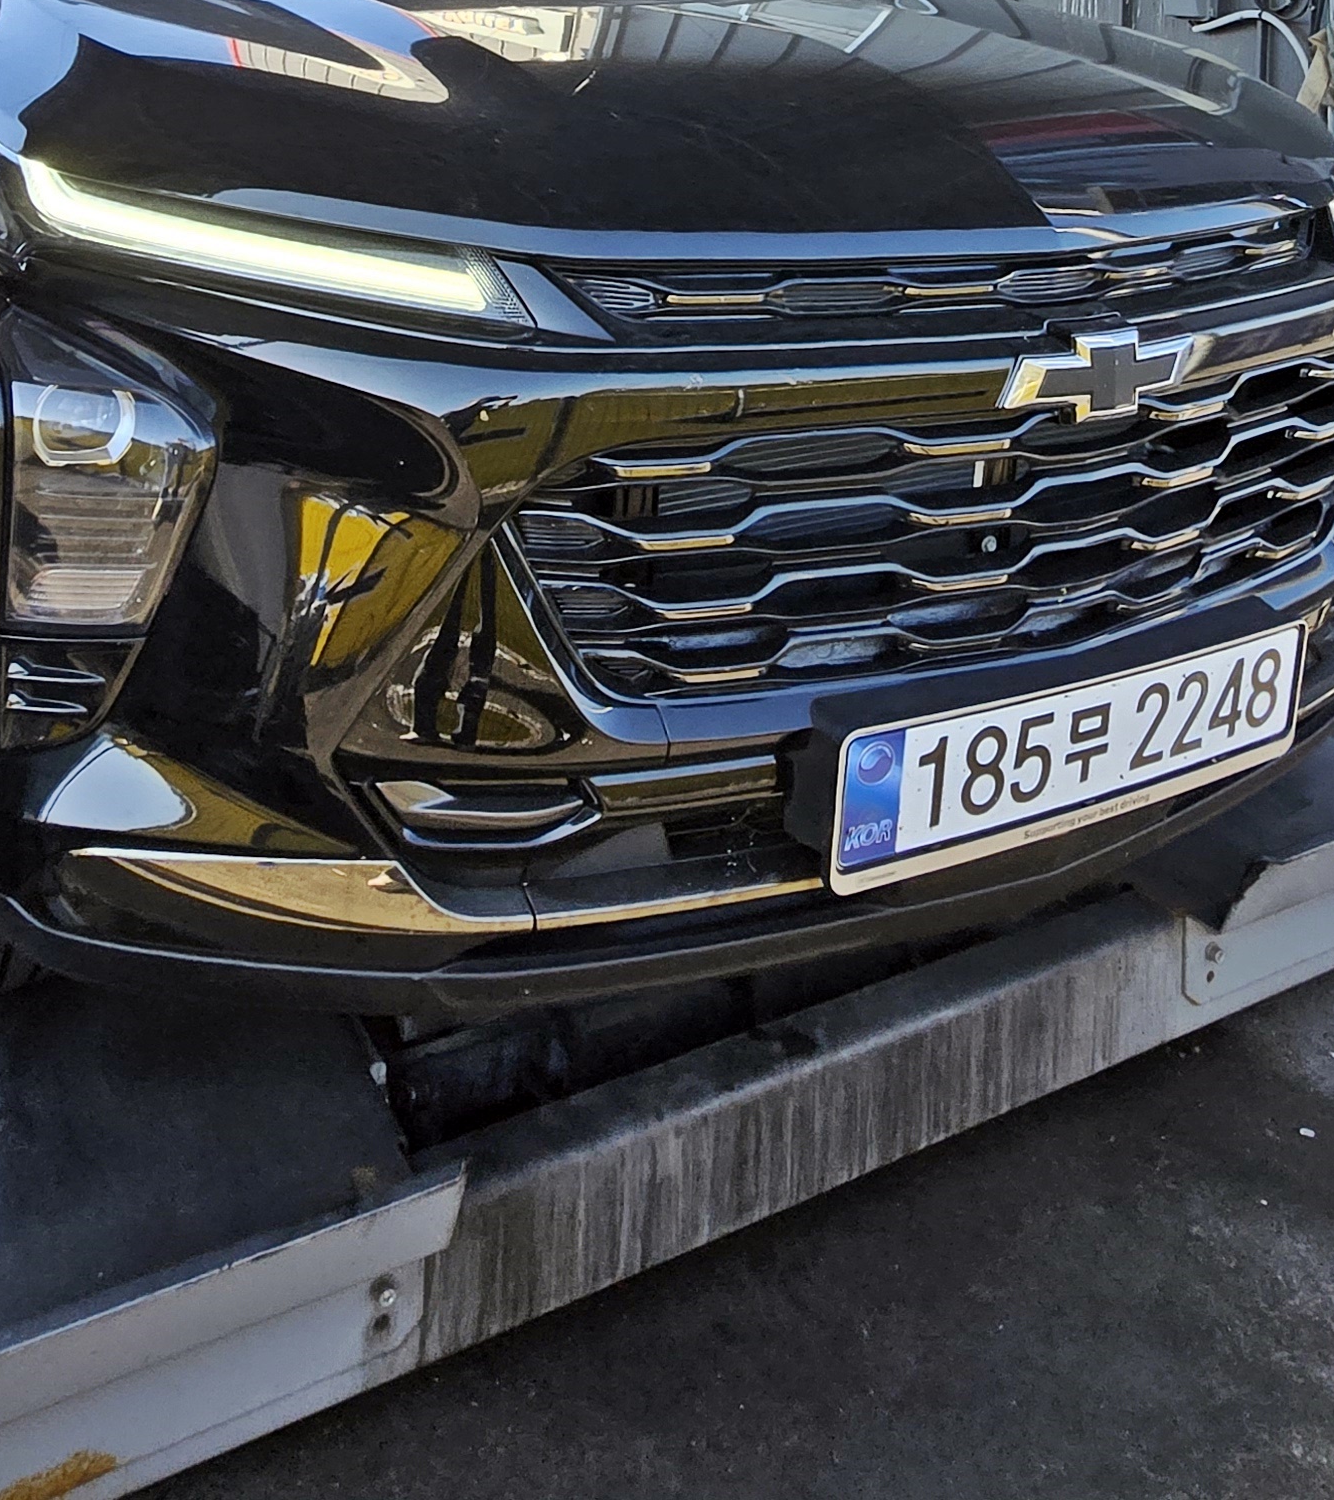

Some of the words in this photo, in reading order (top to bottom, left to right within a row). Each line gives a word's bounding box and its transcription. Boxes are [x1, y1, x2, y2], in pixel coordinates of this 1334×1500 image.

[918, 702, 1112, 829] 185무
[1129, 648, 1282, 772] 2248
[1099, 802, 1119, 816] best
[844, 819, 893, 852] KOR
